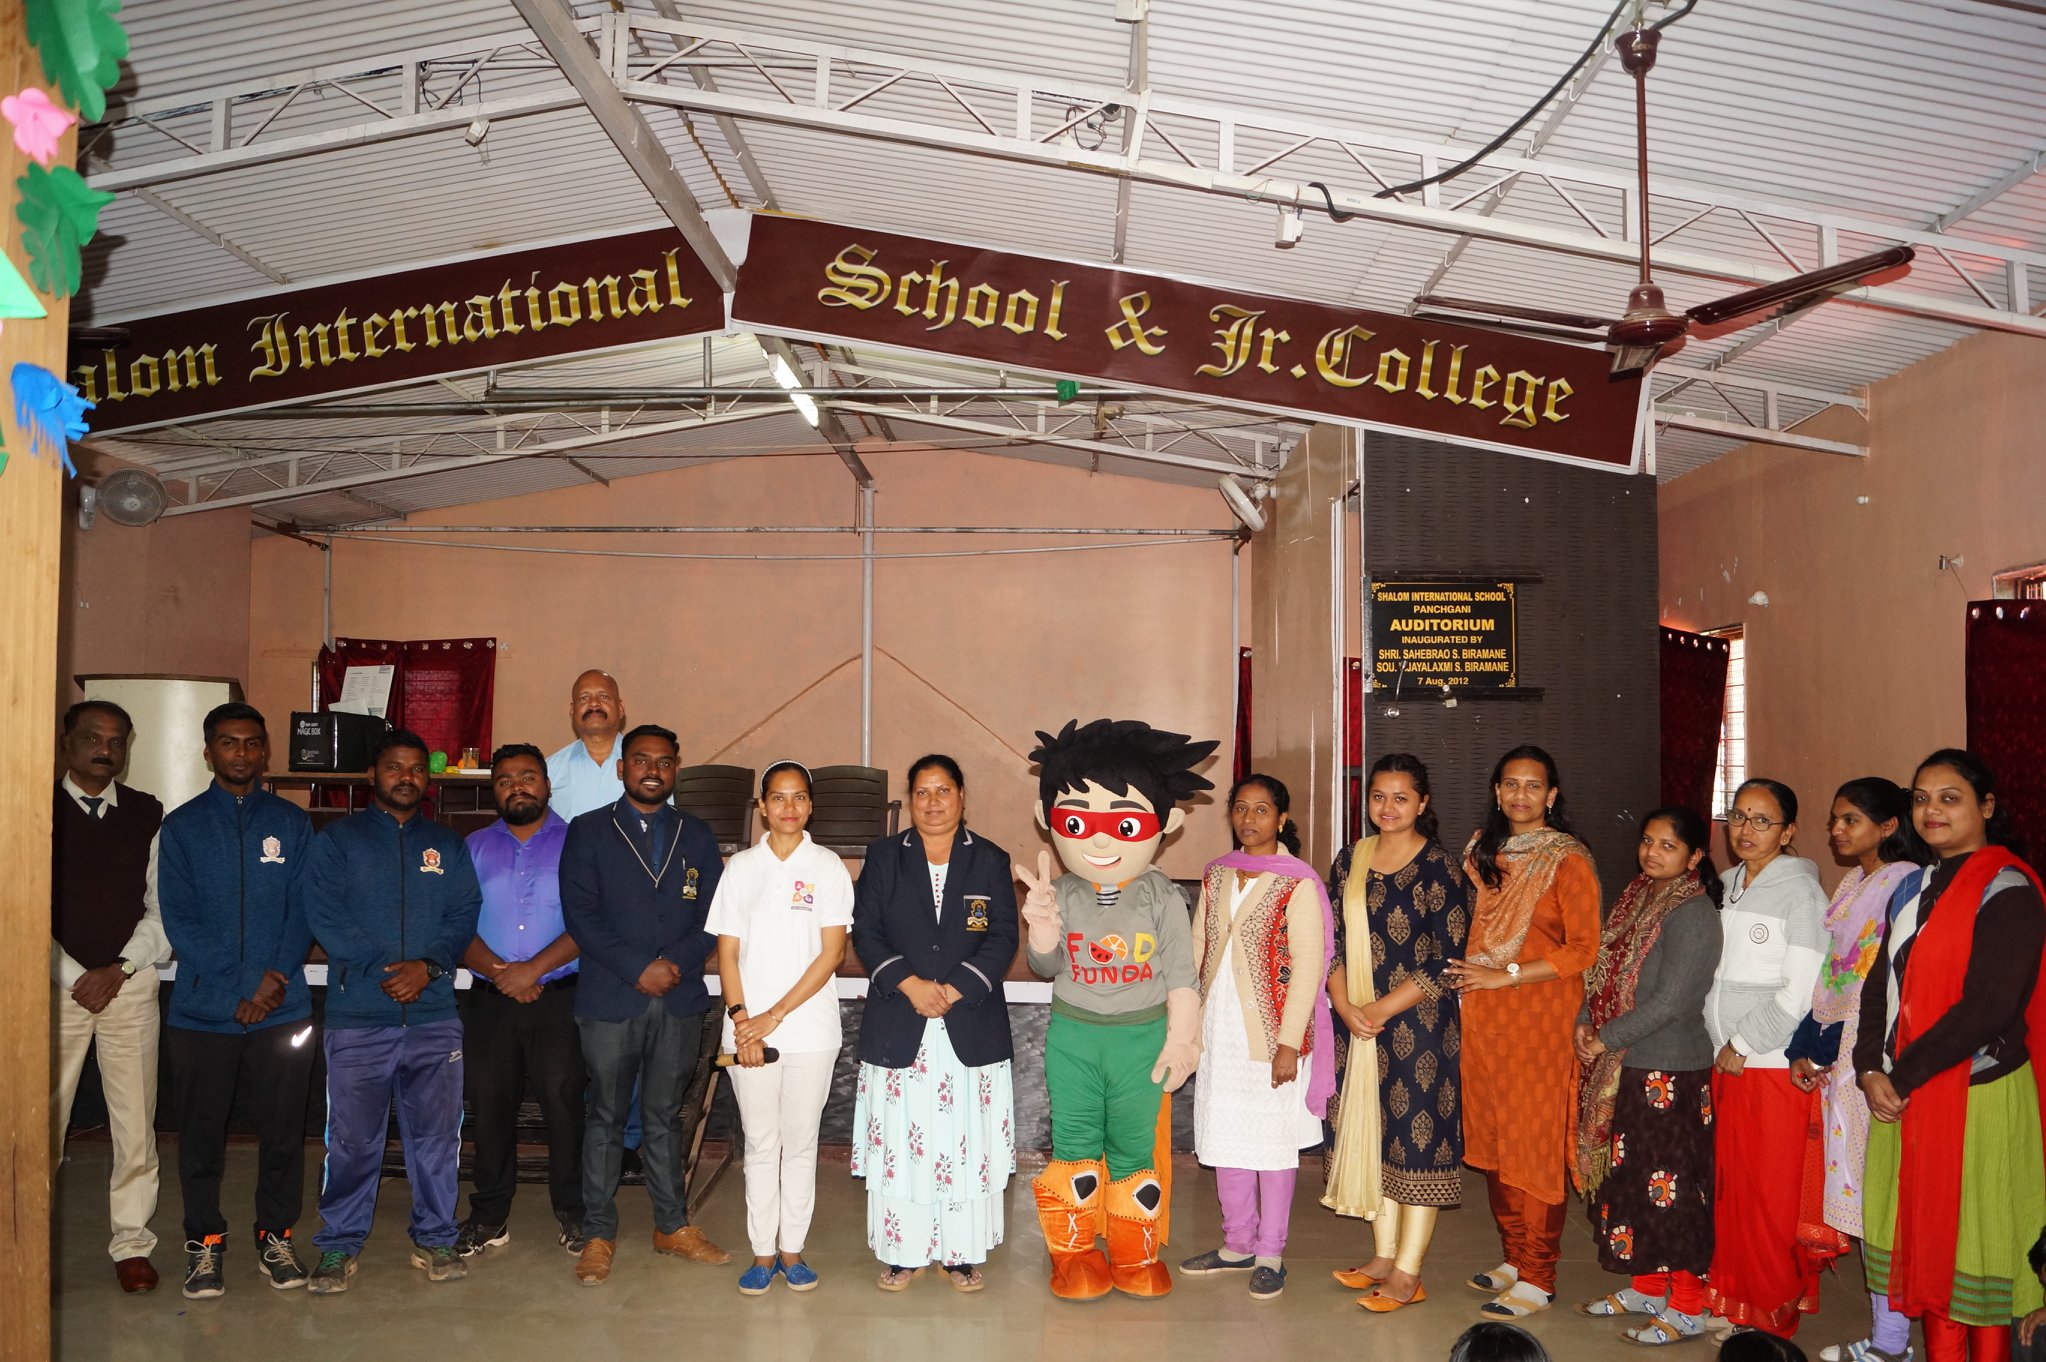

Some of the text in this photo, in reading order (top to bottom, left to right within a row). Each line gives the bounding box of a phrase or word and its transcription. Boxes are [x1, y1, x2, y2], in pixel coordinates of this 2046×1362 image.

[817, 243, 1070, 341] School
[1104, 291, 1168, 356] &
[71, 246, 693, 404] alom International
[1377, 592, 1506, 602] SHALOM INTERNATIONAL SCHOOL
[1413, 605, 1472, 614] PANCHGANI
[1390, 618, 1495, 631] AUDITORIUM
[1401, 635, 1483, 644] INAUGURATED BY
[1378, 649, 1507, 660] SHRI. SAHEBRAO S. BIRAMANE
[1376, 661, 1397, 672] SOU.
[1454, 661, 1463, 672] S.
[1464, 661, 1509, 672] BIRAMANE
[1417, 677, 1469, 687] 7 Aug. 2012
[1071, 961, 1153, 985] FUNDA
